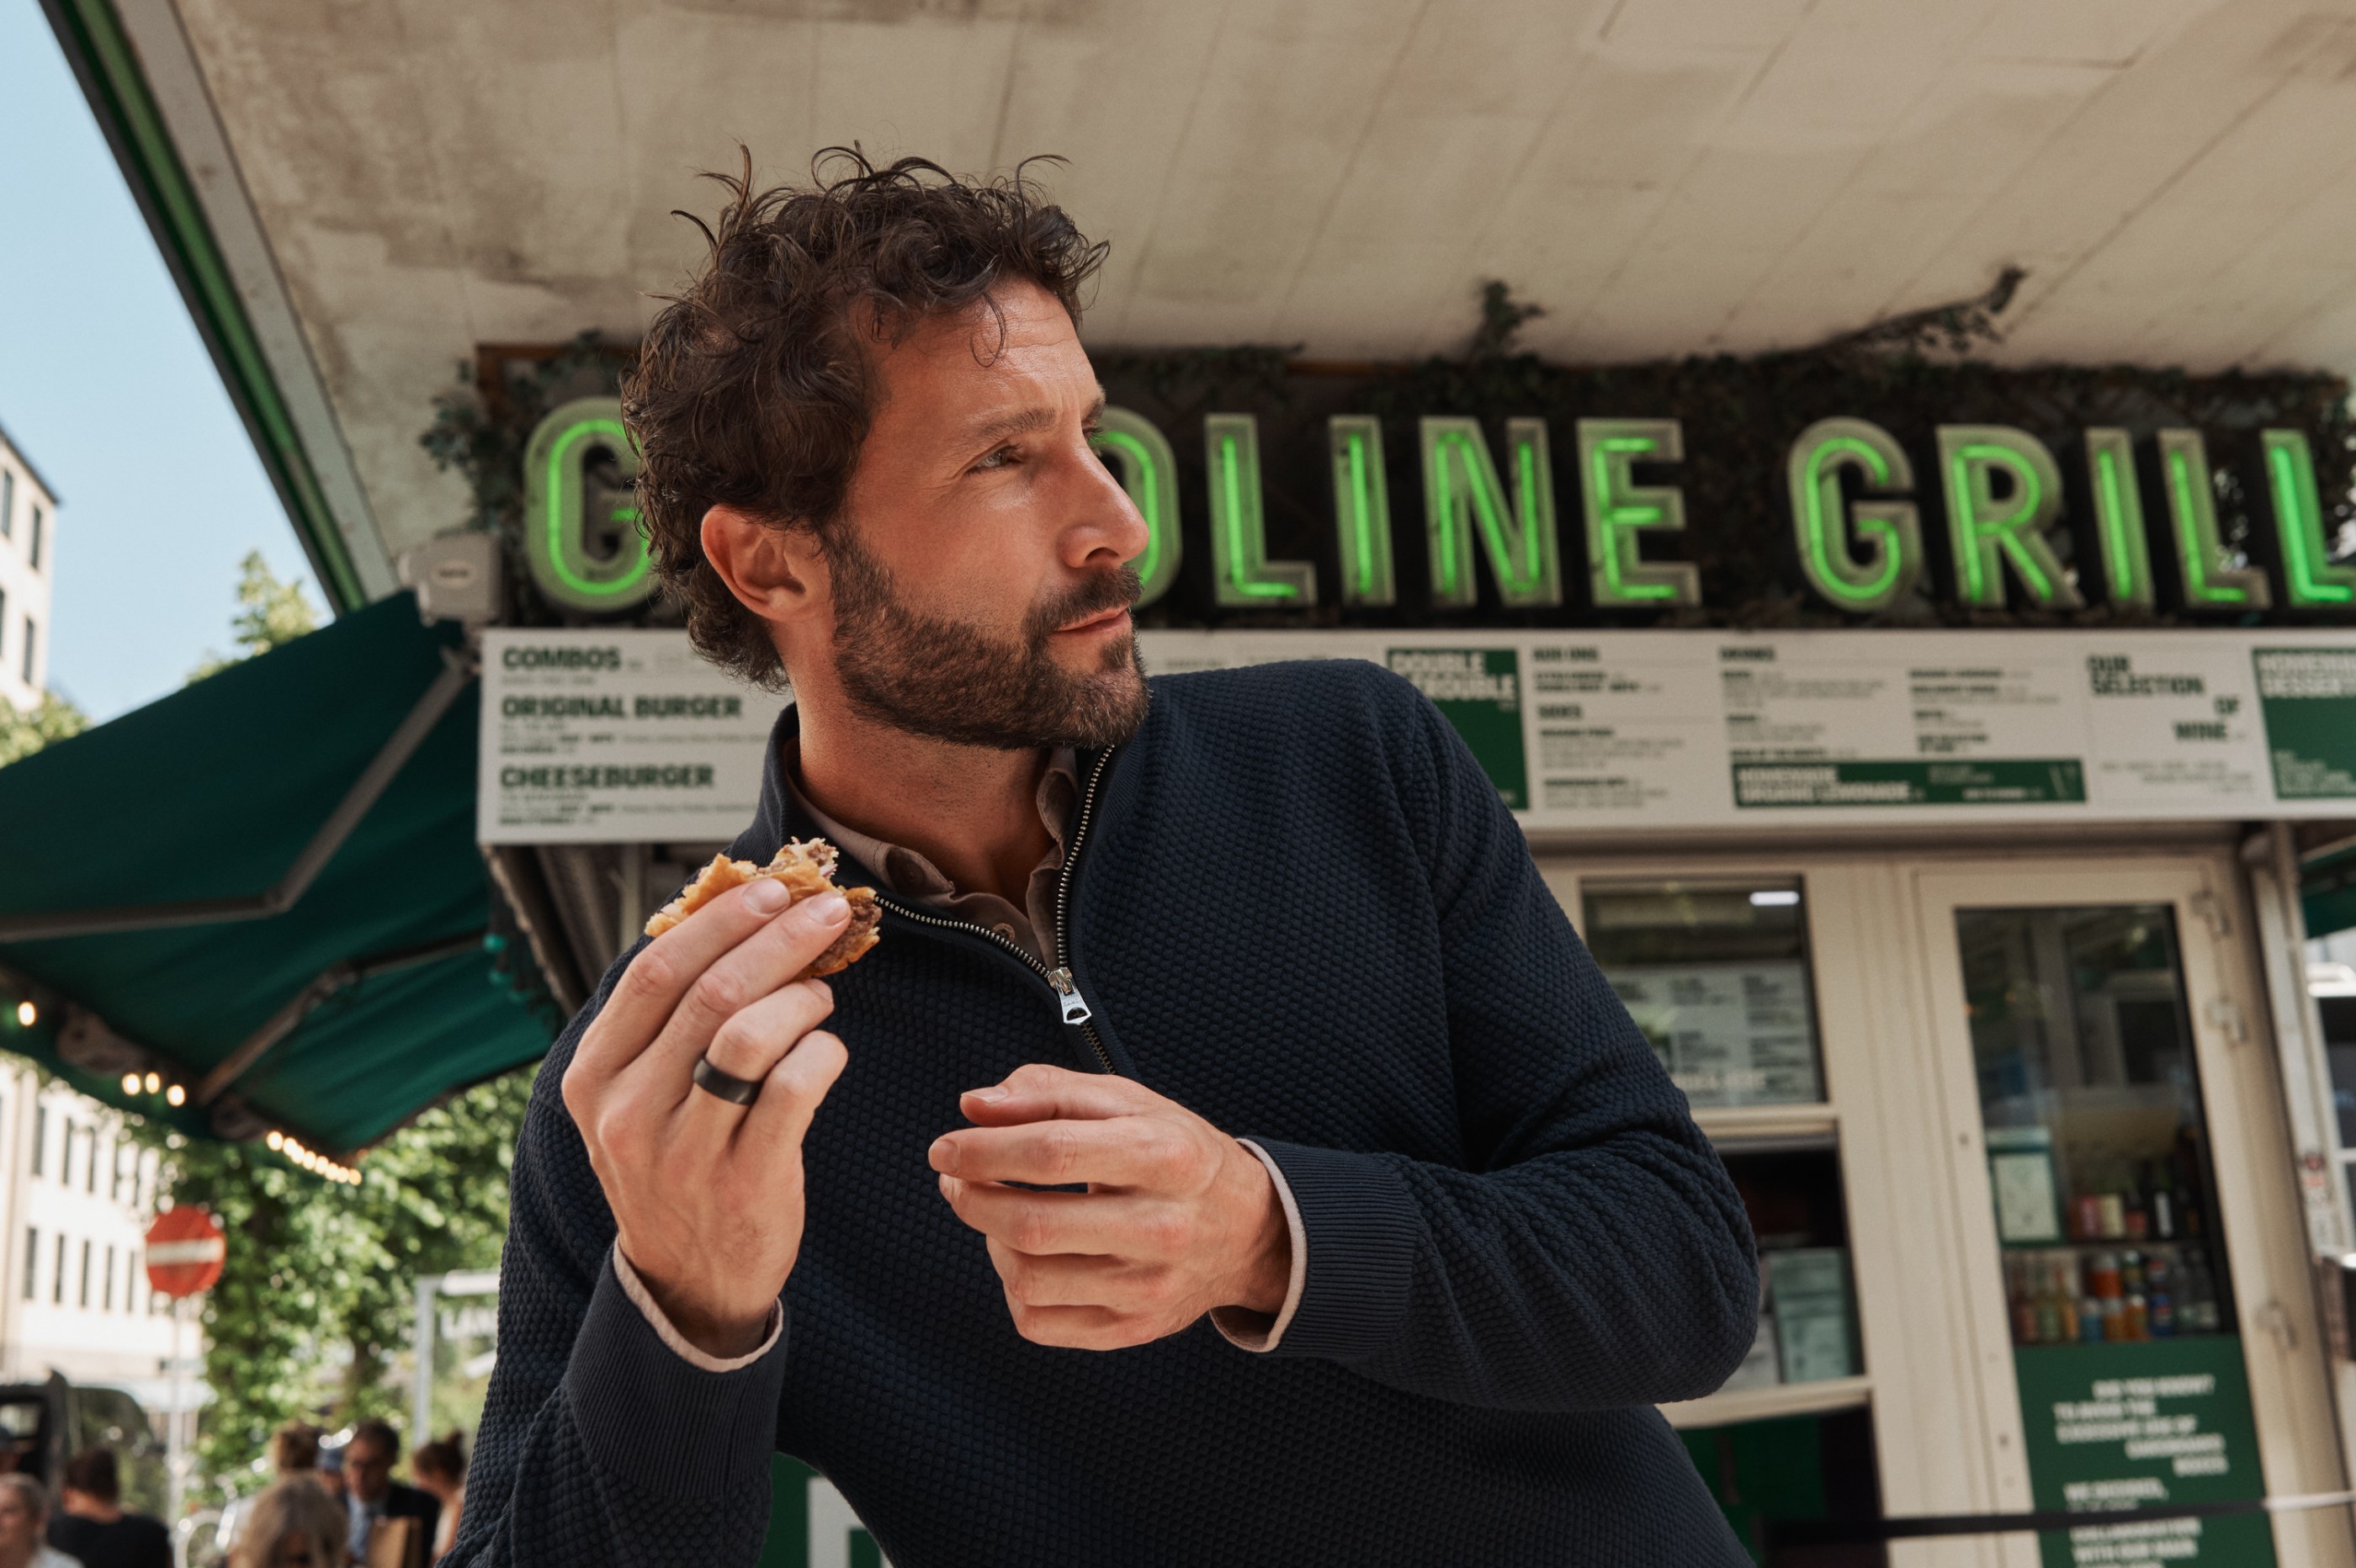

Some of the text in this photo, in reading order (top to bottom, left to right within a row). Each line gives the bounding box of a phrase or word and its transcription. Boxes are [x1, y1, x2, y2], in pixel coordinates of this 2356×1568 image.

[523, 395, 2356, 613] GLINE GRILL
[503, 646, 621, 670] COMBOS
[2087, 654, 2130, 674] OUR
[2091, 674, 2206, 697] SELECTION
[502, 695, 741, 718] ORIGINAL BURGER
[2213, 697, 2240, 715] OF
[2173, 720, 2227, 742] WINE
[501, 764, 714, 789] CHEESEBURGER
